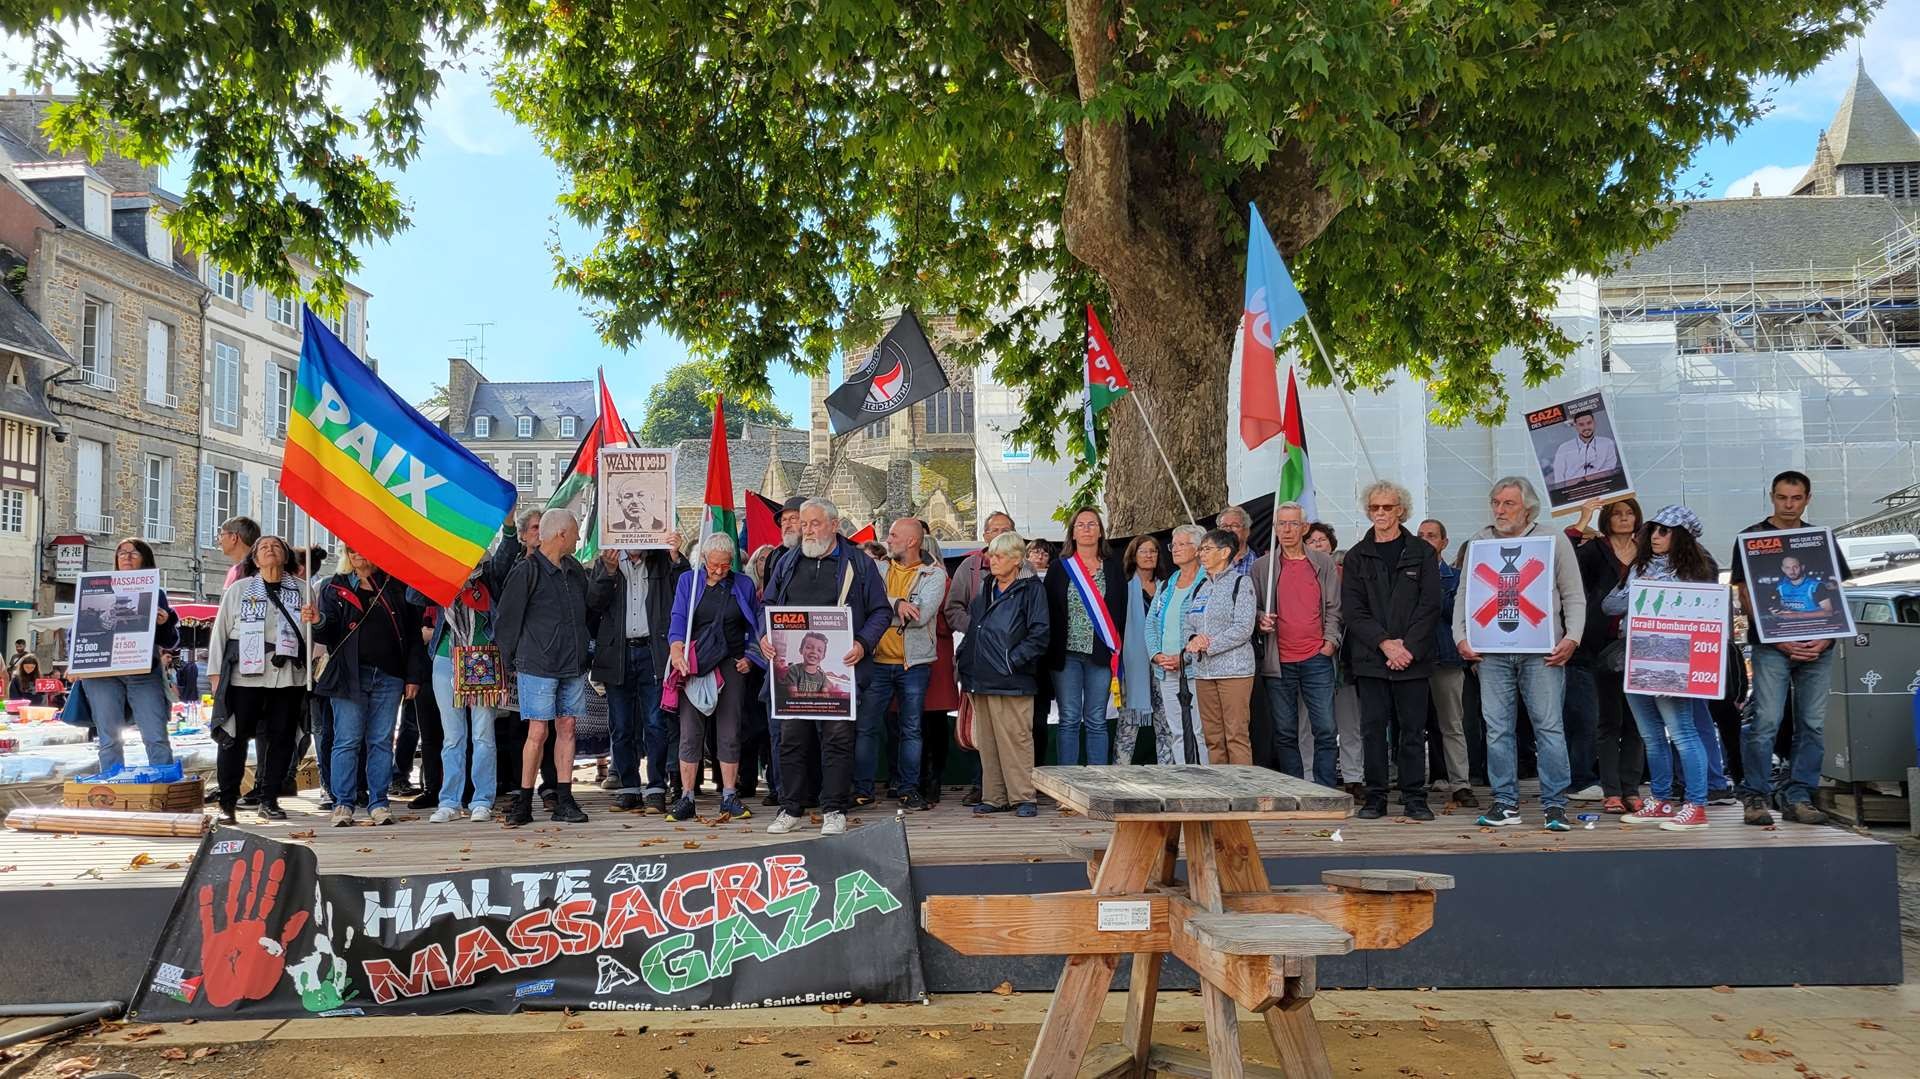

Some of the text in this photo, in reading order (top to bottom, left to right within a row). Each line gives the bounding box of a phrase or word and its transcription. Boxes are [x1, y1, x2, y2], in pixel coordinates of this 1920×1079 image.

[1529, 407, 1562, 424] GAZA
[308, 381, 449, 518] PAIX
[604, 453, 667, 471] WANTED
[1747, 537, 1783, 551] GAZA
[1498, 576, 1520, 588] STOP
[773, 613, 806, 624] GAZA
[1497, 608, 1520, 619] GAZA
[1631, 619, 1721, 633] Israël bombarde GAZA
[75, 644, 84, 652] 15
[1693, 641, 1719, 654] 2014
[1691, 671, 1718, 683] 2024
[363, 863, 668, 938] HALTE AU
[361, 855, 809, 1005] MASSACRE
[640, 869, 902, 995] GAZA
[589, 1001, 651, 1010] collectif
[763, 991, 852, 1008] Saint-Brieuc
